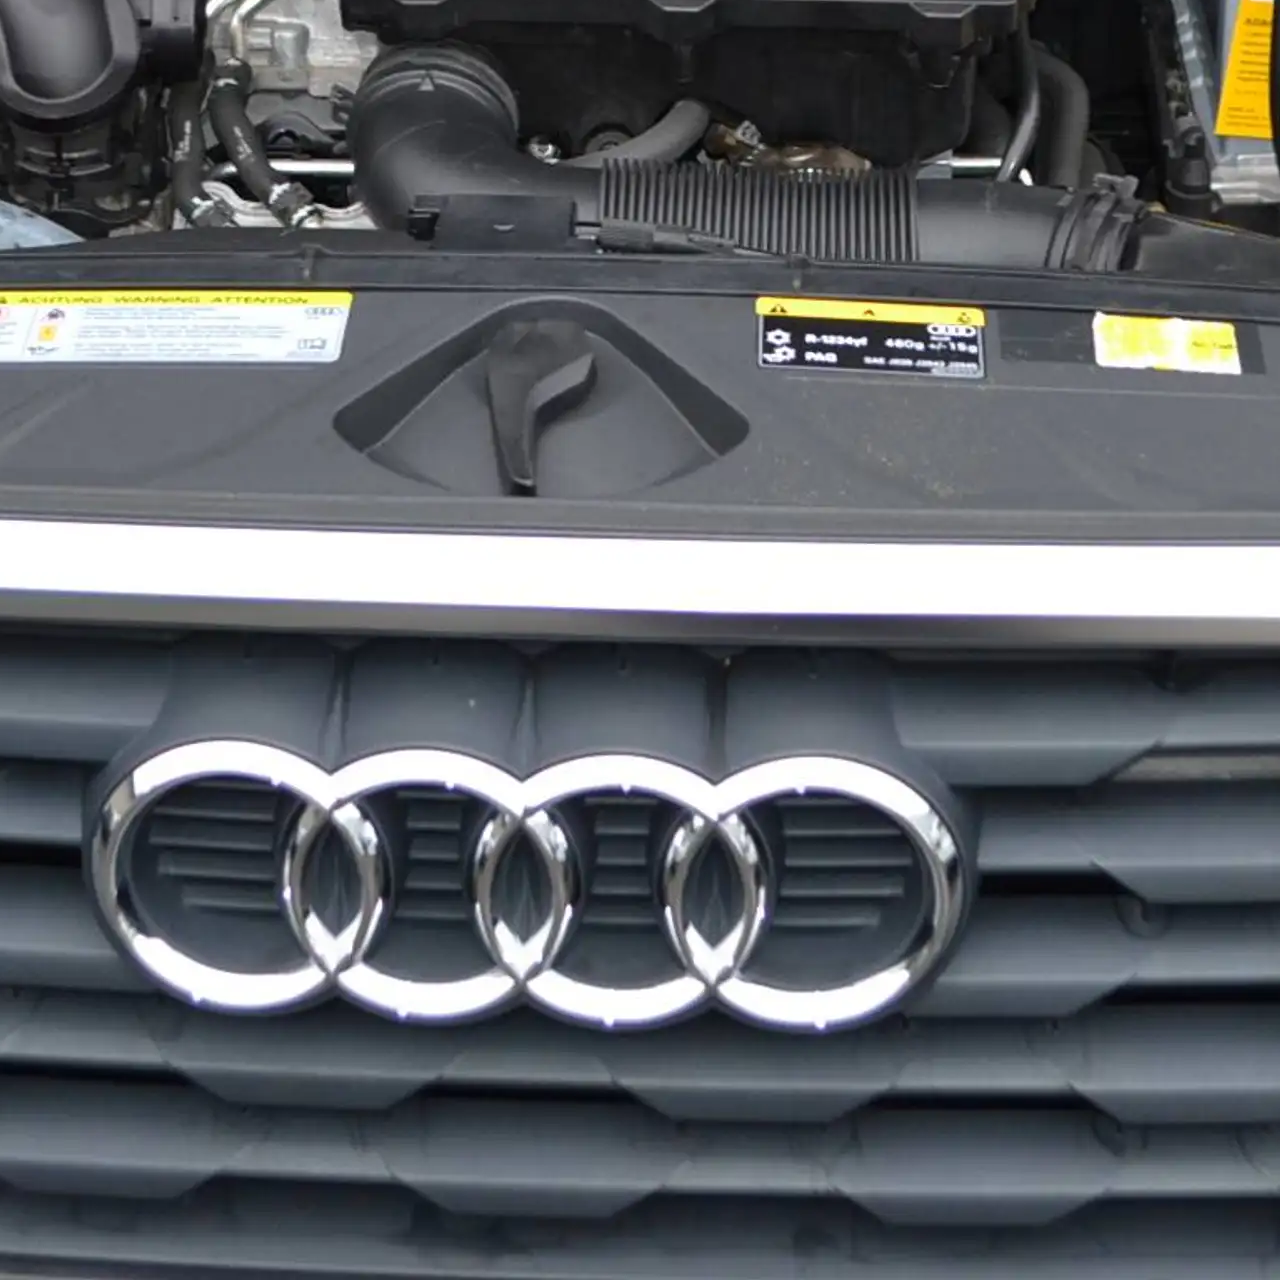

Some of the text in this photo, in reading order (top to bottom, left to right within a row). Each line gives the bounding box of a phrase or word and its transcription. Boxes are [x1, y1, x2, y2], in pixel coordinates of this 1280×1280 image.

[18, 296, 308, 305] ACHTUNG WARNING ATTENTION
